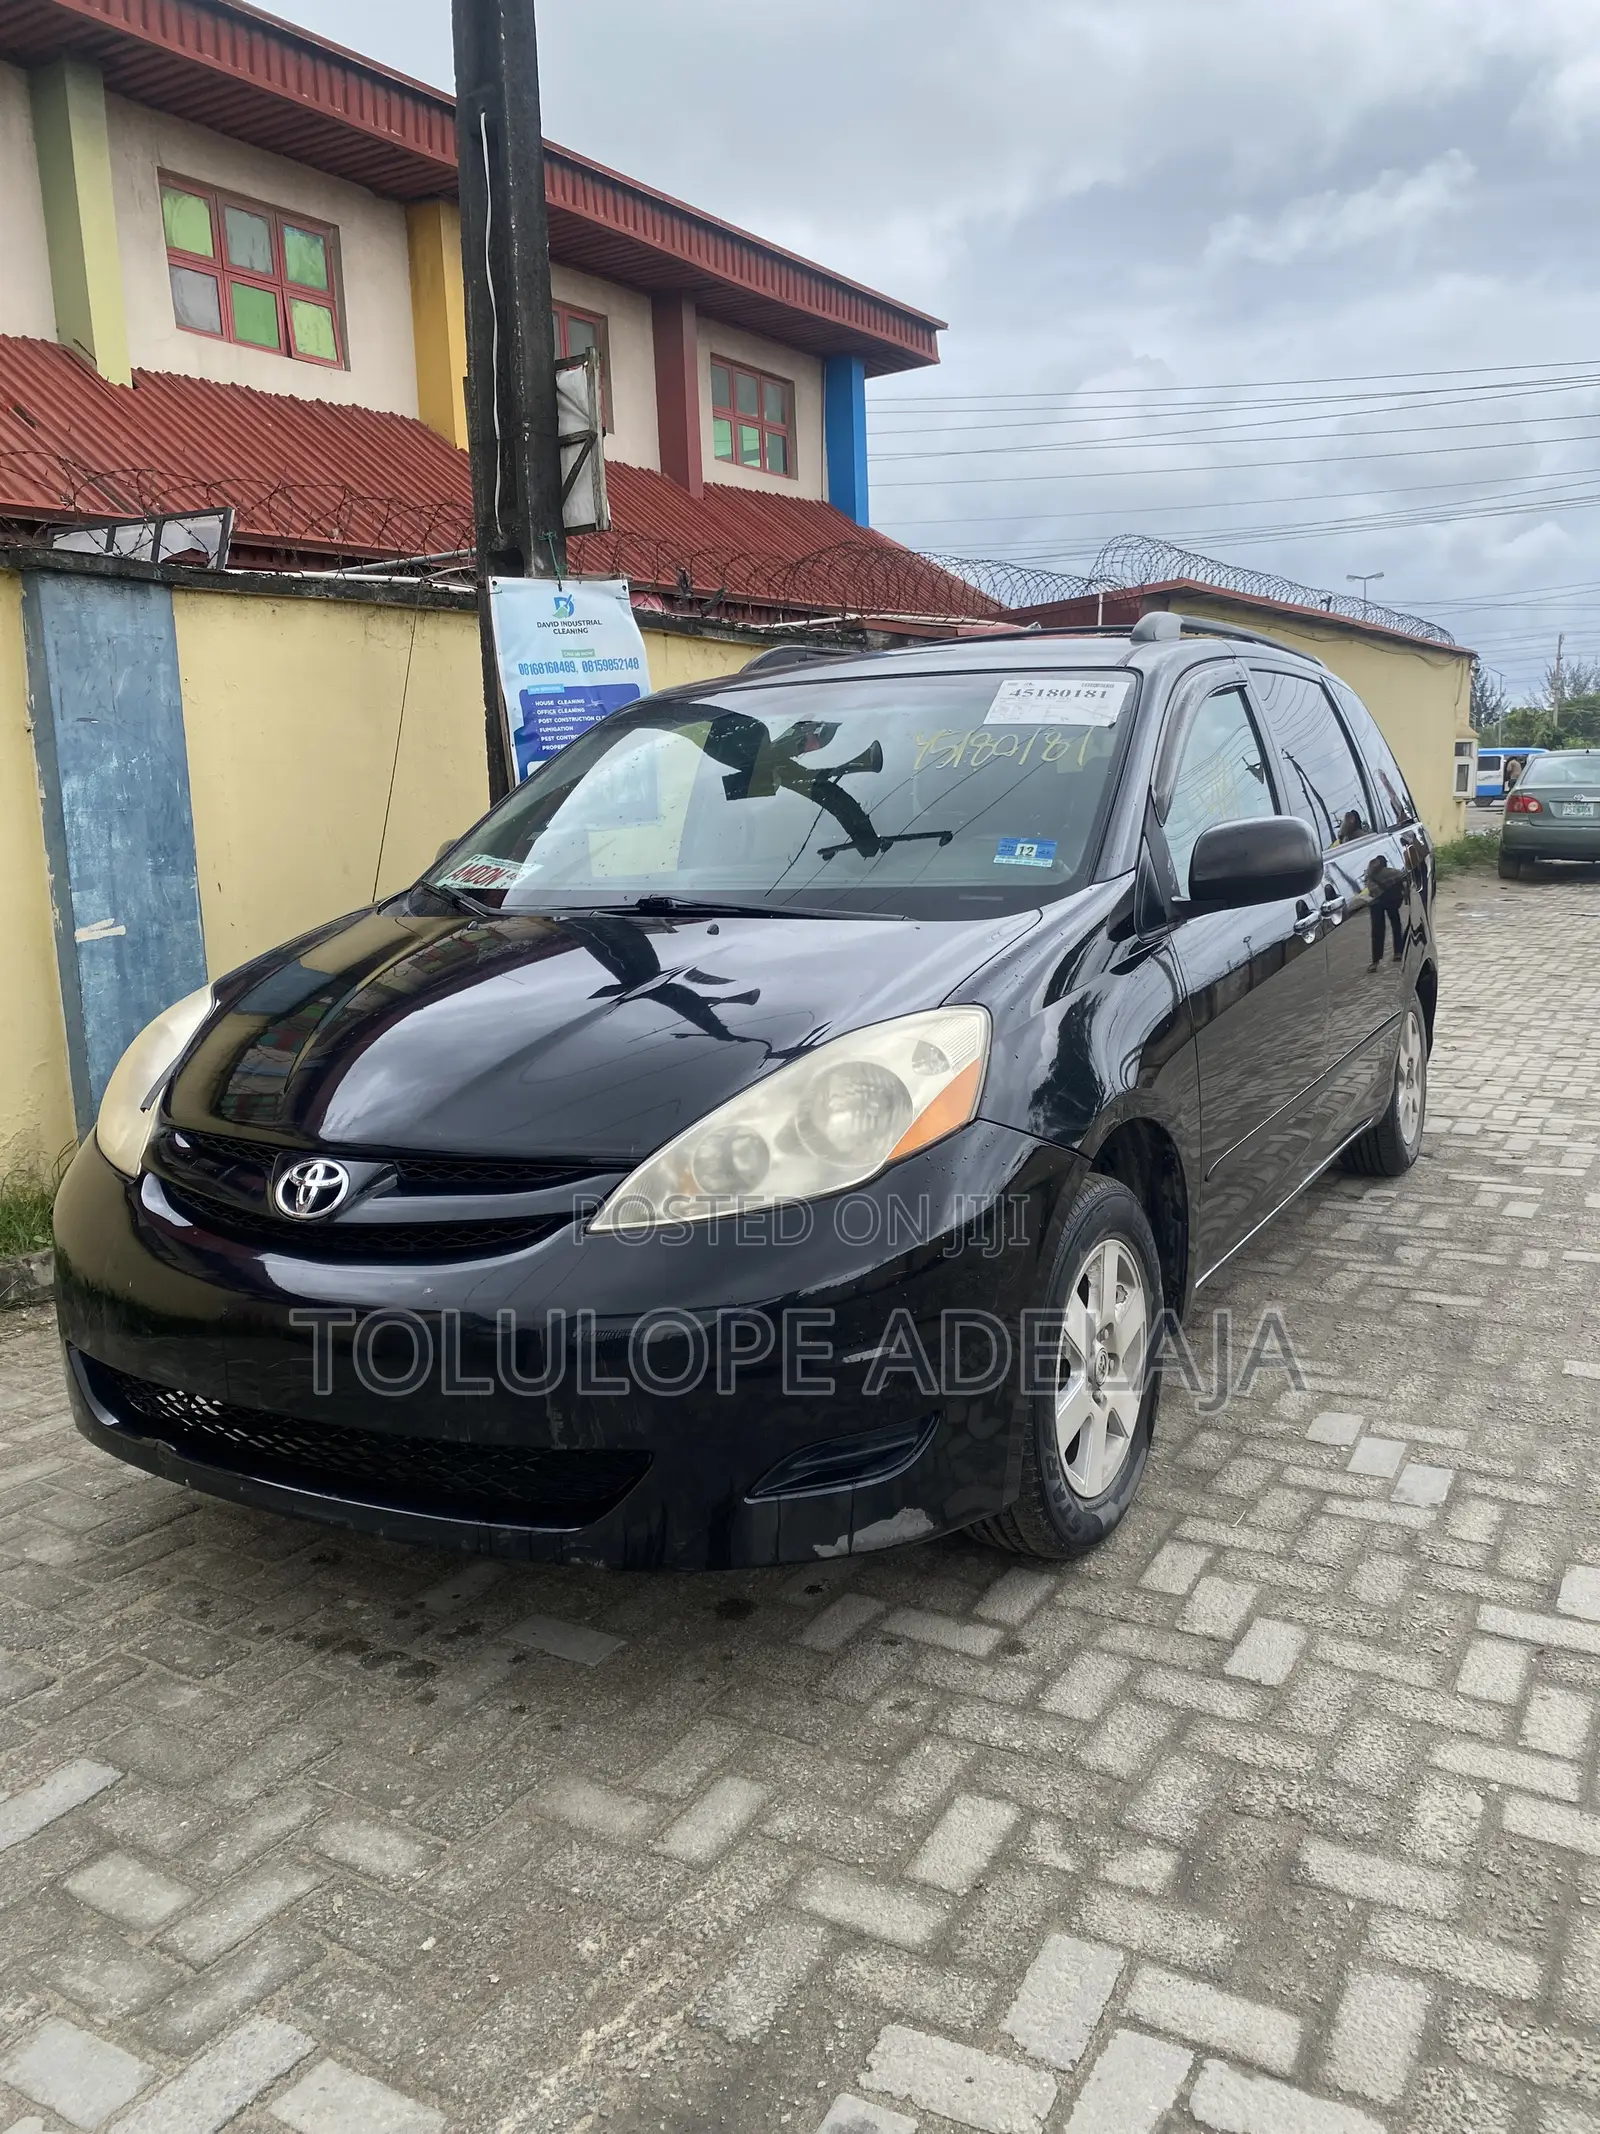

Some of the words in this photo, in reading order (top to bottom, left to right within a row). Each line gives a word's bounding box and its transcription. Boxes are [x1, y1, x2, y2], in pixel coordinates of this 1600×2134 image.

[560, 619, 602, 627] INDUSTRIAL
[553, 627, 589, 635] CLEANING
[1009, 688, 1106, 699] 45180181
[1019, 845, 1035, 857] 12
